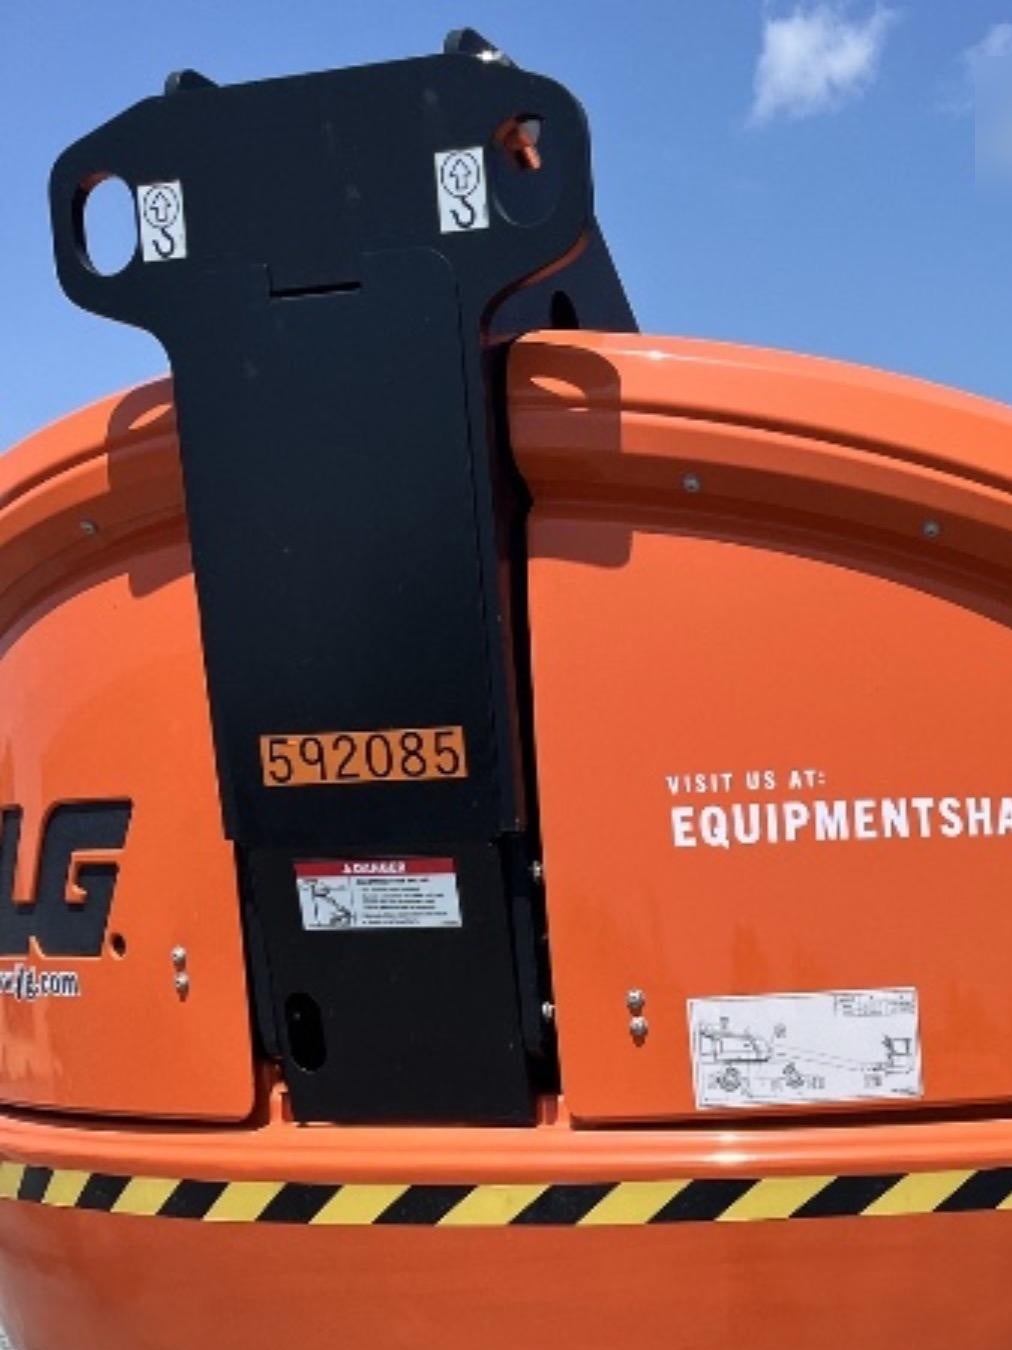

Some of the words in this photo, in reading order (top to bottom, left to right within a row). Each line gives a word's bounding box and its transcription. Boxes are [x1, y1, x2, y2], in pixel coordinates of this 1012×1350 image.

[268, 731, 459, 783] 592085
[665, 773, 733, 796] VISIT
[746, 770, 775, 791] US
[788, 768, 827, 791] AT:
[0, 798, 132, 958] LG
